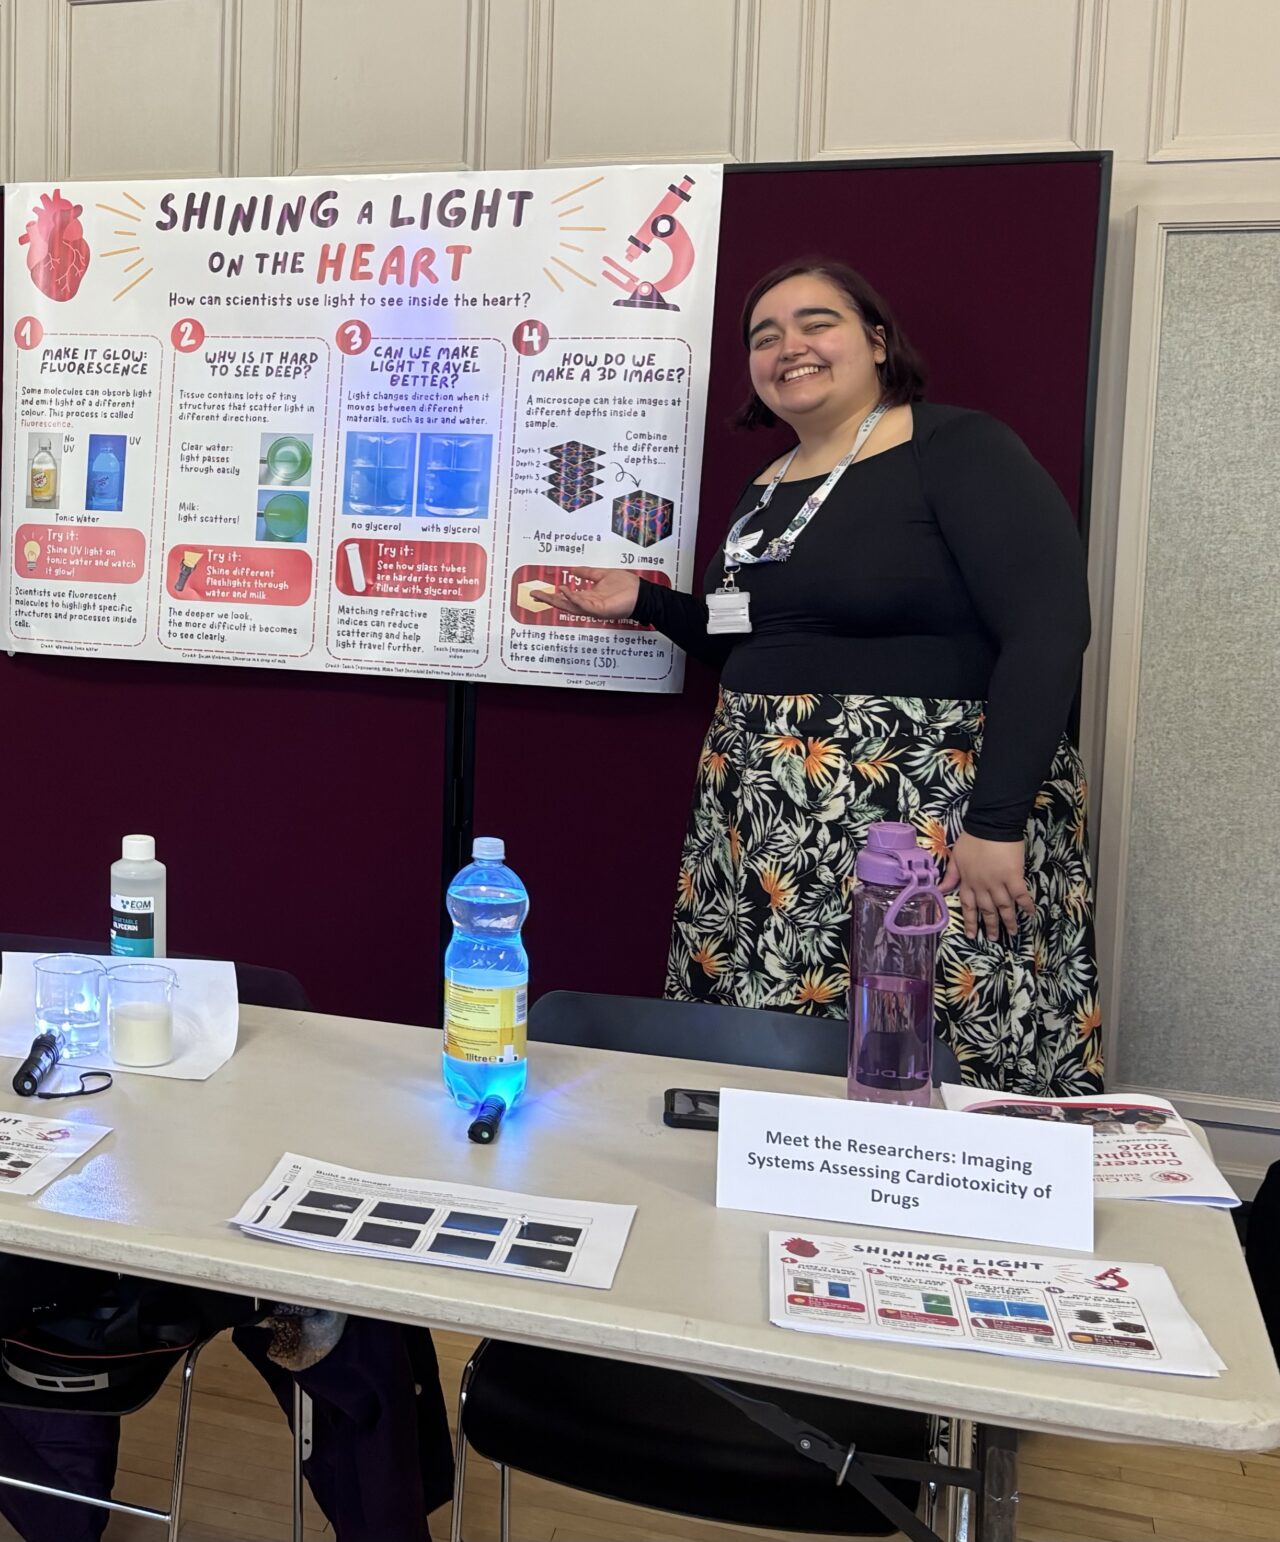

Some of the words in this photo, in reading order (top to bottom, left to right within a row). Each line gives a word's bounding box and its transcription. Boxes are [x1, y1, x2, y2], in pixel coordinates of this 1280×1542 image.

[155, 190, 339, 236] SHINING
[356, 200, 374, 225] A
[390, 188, 534, 231] LIGHT
[208, 250, 244, 278] ON
[255, 252, 305, 275] THE
[316, 242, 472, 288] HEART
[169, 292, 195, 307] How
[200, 294, 221, 306] can
[226, 292, 292, 307] scientists
[297, 294, 319, 307] use
[324, 292, 354, 309] light
[360, 294, 376, 307] to
[380, 294, 403, 307] see
[408, 293, 449, 307] inside
[454, 292, 478, 307] the
[482, 292, 531, 308] heart?
[21, 321, 31, 346] 1
[180, 322, 196, 347] 2
[344, 325, 362, 350] 3
[523, 326, 540, 351] 4
[42, 348, 79, 361] MAKE
[84, 349, 97, 361] IT
[102, 349, 147, 362] GLOW:
[205, 351, 236, 364] WHY
[242, 352, 255, 364] IS
[260, 352, 274, 364] IT
[280, 352, 318, 365] HARD
[374, 346, 403, 359] CAN
[410, 346, 431, 359] WE
[438, 346, 479, 360] MAKE
[562, 353, 598, 367] HOW
[604, 354, 625, 366] DO
[632, 354, 656, 367] WE
[40, 362, 148, 376] FLUORESCENCE
[210, 365, 229, 377] TO
[234, 365, 260, 378] SEE
[266, 365, 312, 379] DEEP?
[371, 360, 415, 373] LIGHT
[422, 360, 480, 374] TRAVEL
[390, 374, 459, 389] BETTER?
[532, 368, 574, 382] MAKE
[580, 369, 591, 382] A
[597, 368, 617, 381] 3D
[624, 368, 686, 383] IMAGE?
[181, 442, 203, 452] Clear
[206, 443, 233, 452] water:
[366, 523, 402, 532] glycerol
[422, 525, 441, 533] with
[444, 526, 480, 535] glycerol
[620, 554, 635, 564] 3D
[638, 556, 664, 565] image
[130, 900, 151, 909] EQM
[766, 1130, 809, 1148] Meet
[814, 1134, 842, 1152] the
[848, 1138, 957, 1164] Researchers:
[962, 1152, 1033, 1176] Imaging
[1118, 1143, 1173, 1151] 2026
[747, 1152, 815, 1173] Systems
[820, 1159, 901, 1185] Assessing
[905, 1169, 1028, 1200] Cardiotoxicity
[1033, 1184, 1053, 1200] of
[871, 1188, 920, 1210] Drugs
[852, 1244, 947, 1262] SHINING
[972, 1260, 1044, 1271] LIGHT
[882, 1258, 905, 1266] ON
[908, 1260, 933, 1268] THE
[940, 1262, 1017, 1278] HEART
